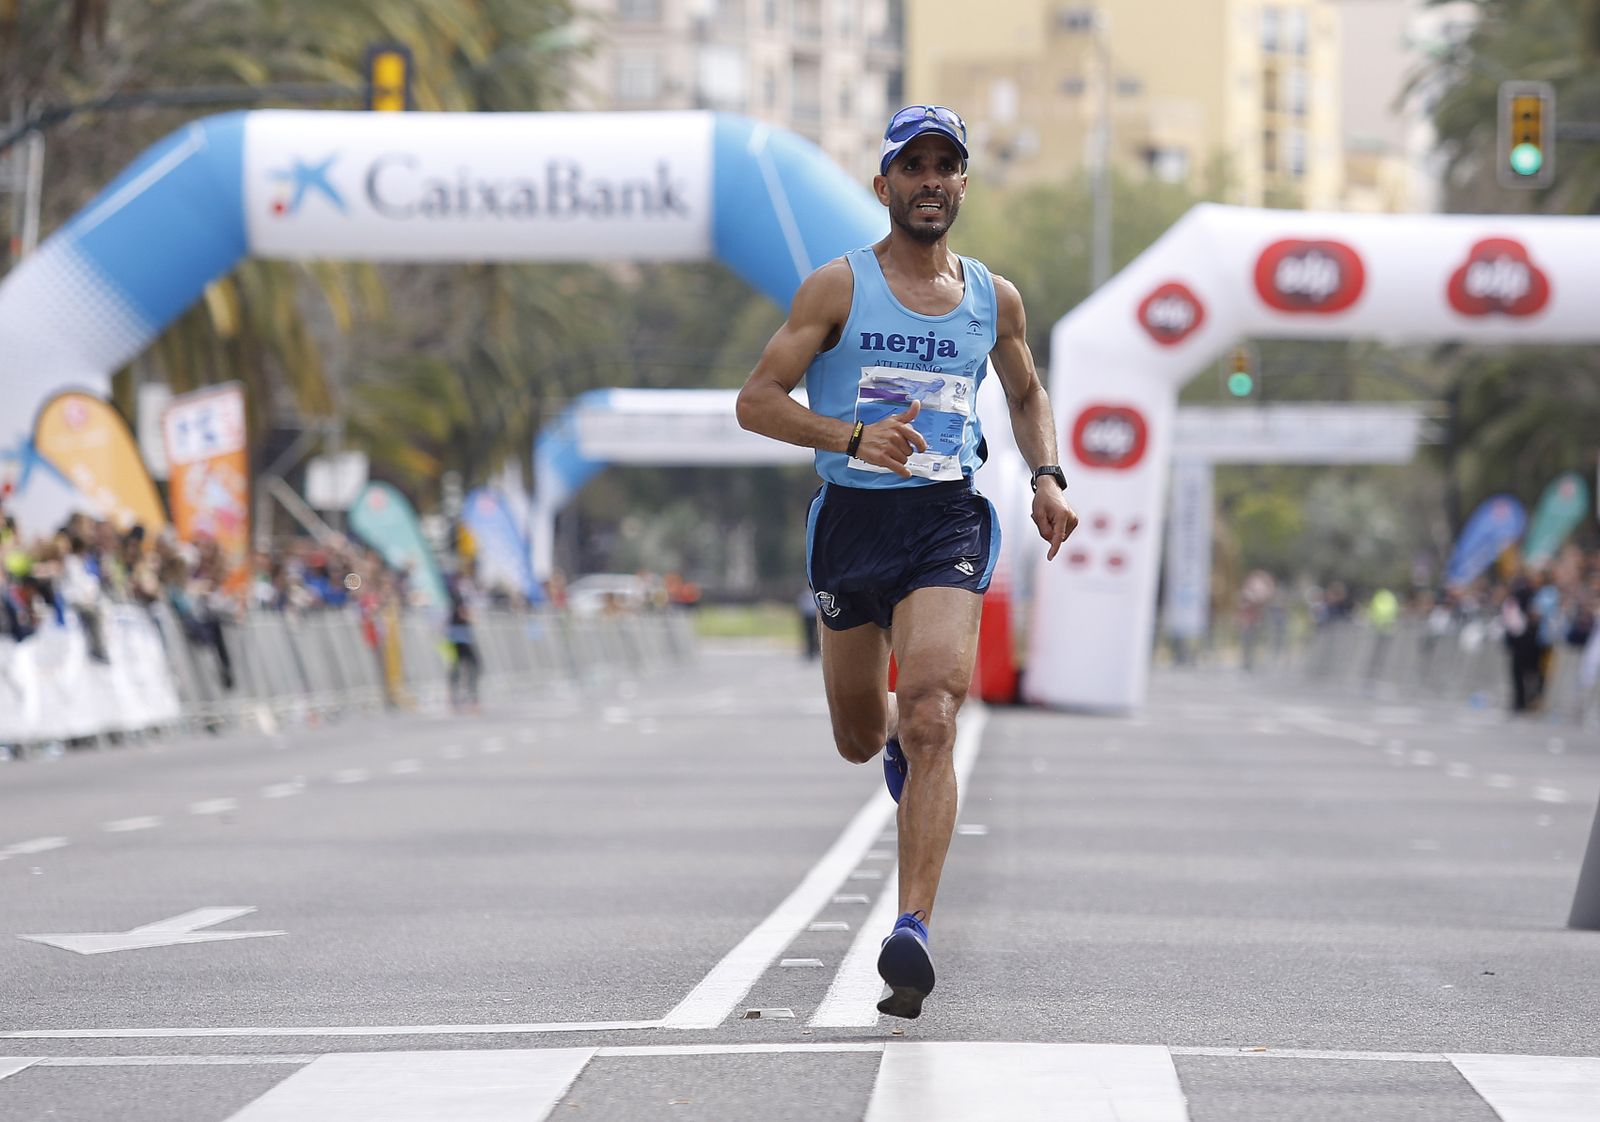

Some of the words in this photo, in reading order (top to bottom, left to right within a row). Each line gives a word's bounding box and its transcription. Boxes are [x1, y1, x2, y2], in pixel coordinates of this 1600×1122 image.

[363, 153, 691, 220] CaixaBank
[860, 331, 959, 362] nerja
[874, 359, 943, 374] ATLETISMO
